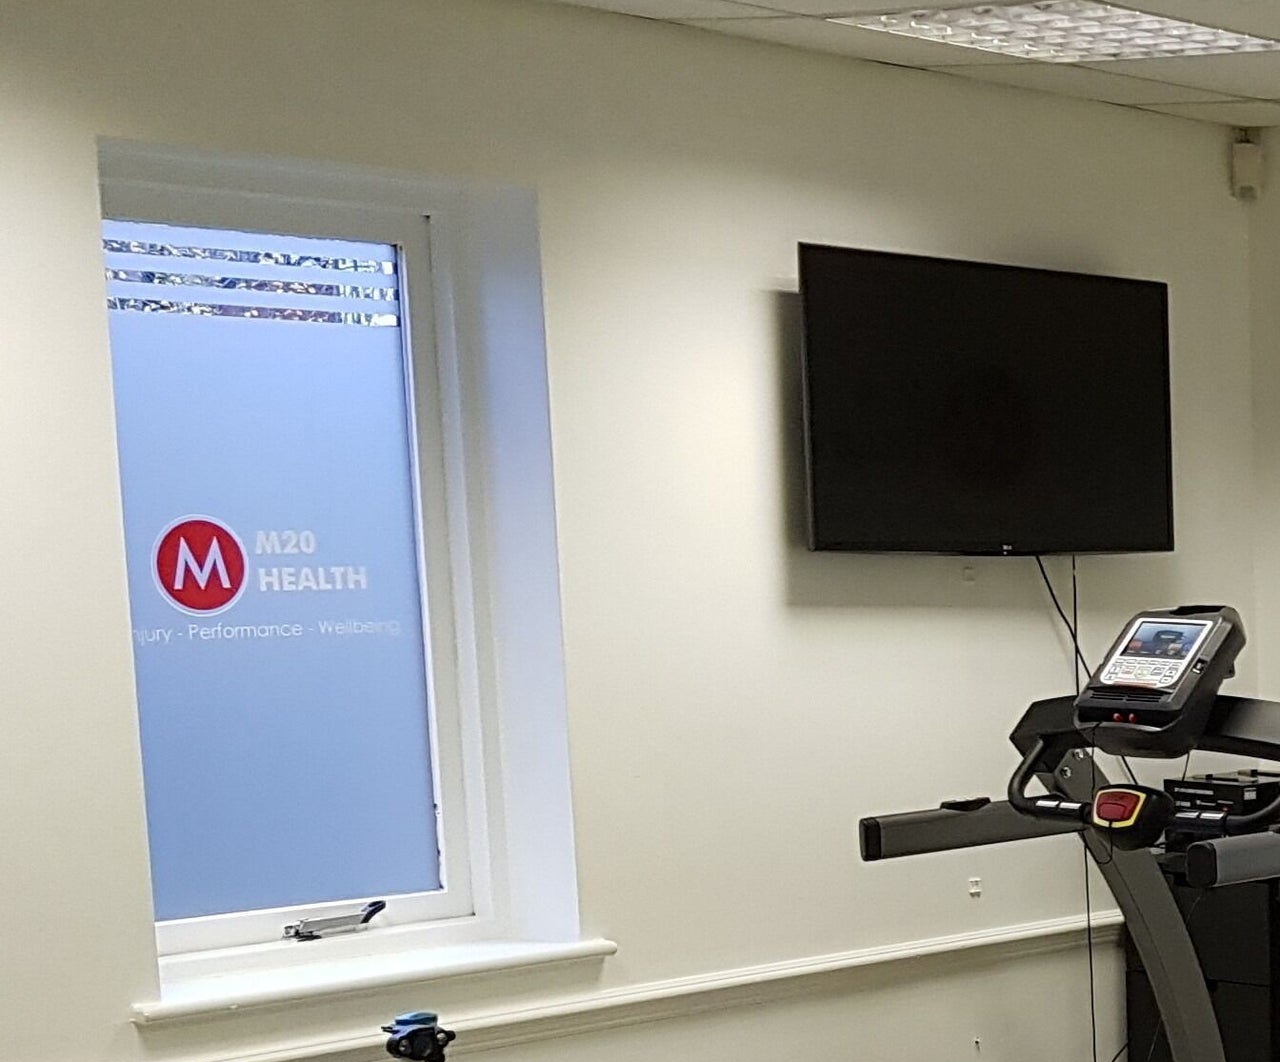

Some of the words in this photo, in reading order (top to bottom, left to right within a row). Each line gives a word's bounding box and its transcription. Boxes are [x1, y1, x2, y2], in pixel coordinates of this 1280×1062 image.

[254, 530, 316, 555] M20
[259, 566, 368, 592] HEALTH
[133, 628, 173, 647] njury
[188, 622, 304, 641] Performance
